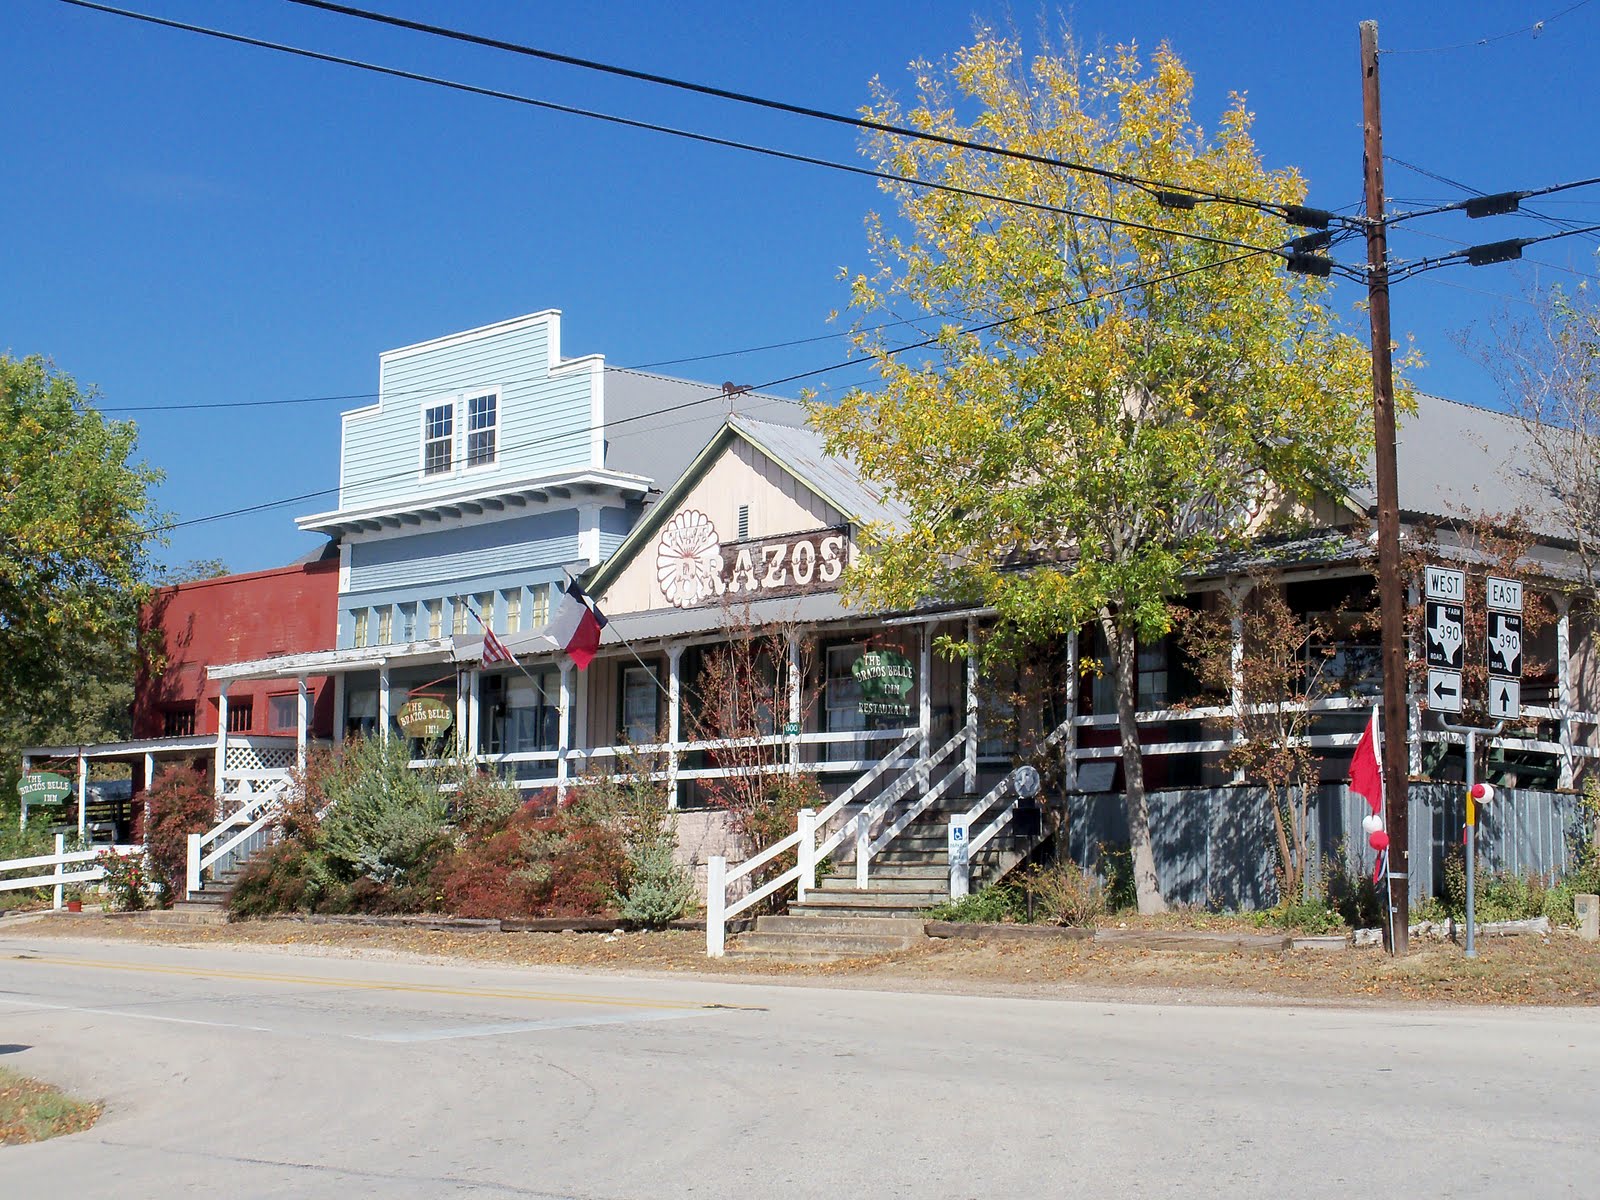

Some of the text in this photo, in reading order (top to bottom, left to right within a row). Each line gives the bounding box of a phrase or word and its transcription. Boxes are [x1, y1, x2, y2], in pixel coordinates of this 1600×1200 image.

[673, 535, 844, 601] BRAZOS
[1431, 574, 1460, 595] WEST
[1493, 585, 1518, 605] EAST
[1447, 607, 1461, 616] FARM
[1507, 617, 1519, 625] FARM
[1439, 624, 1459, 641] 390
[1499, 633, 1518, 650] 390
[863, 655, 881, 666] THE
[1430, 652, 1443, 661] ROAD
[1491, 660, 1503, 669] ROAD
[855, 664, 913, 683] BRAZOS BELLE
[884, 683, 900, 695] INN
[407, 702, 423, 712] THE
[858, 702, 910, 717] RESTAURANT
[400, 709, 451, 727] BRAZOS BELLE
[26, 775, 42, 783] THE
[19, 781, 69, 795] BRAZOS BELLE
[43, 794, 58, 802] INN
